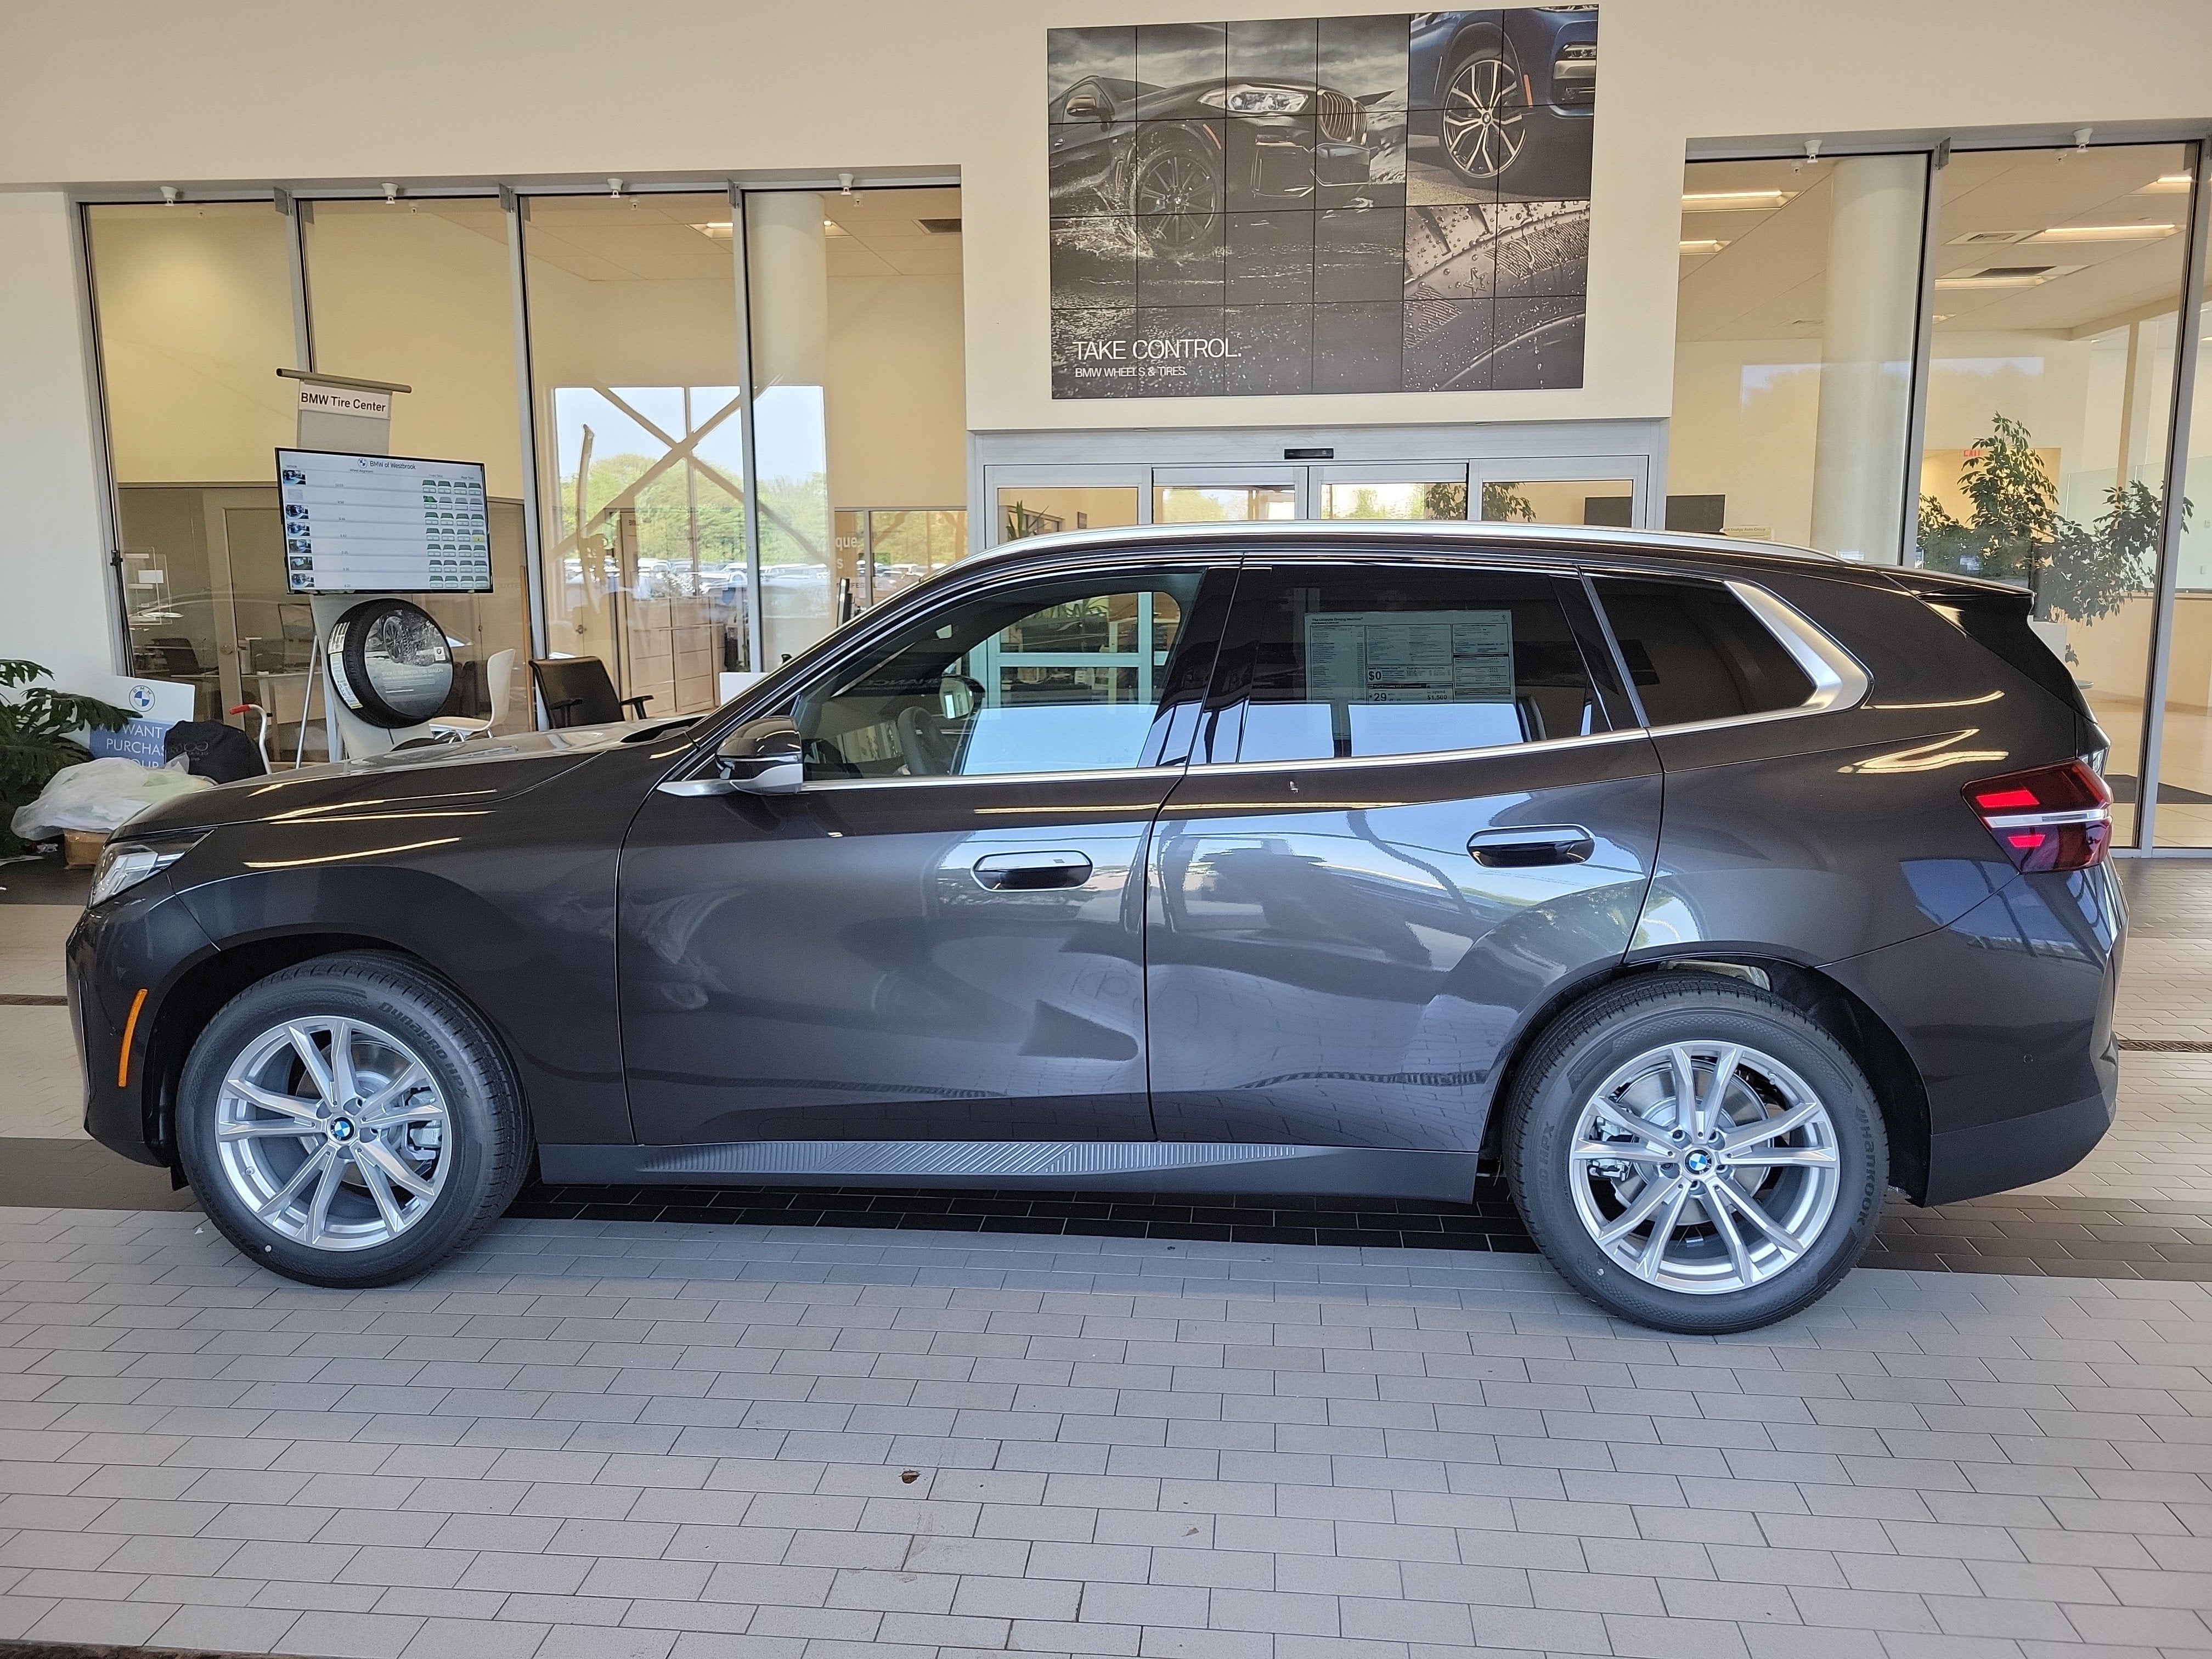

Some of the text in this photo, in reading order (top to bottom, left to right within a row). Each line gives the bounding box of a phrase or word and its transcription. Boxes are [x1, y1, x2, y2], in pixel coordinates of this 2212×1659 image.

[1073, 338, 1242, 360] TAKE CONTROL.
[1075, 366, 1188, 377] BMW WHEELS & TIRES.
[301, 392, 386, 412] BMW Tire Center
[1368, 670, 1382, 681] $0
[133, 686, 152, 695] BMW
[1373, 692, 1387, 702] 29
[122, 723, 163, 738] WANT
[445, 1063, 470, 1099] HPX
